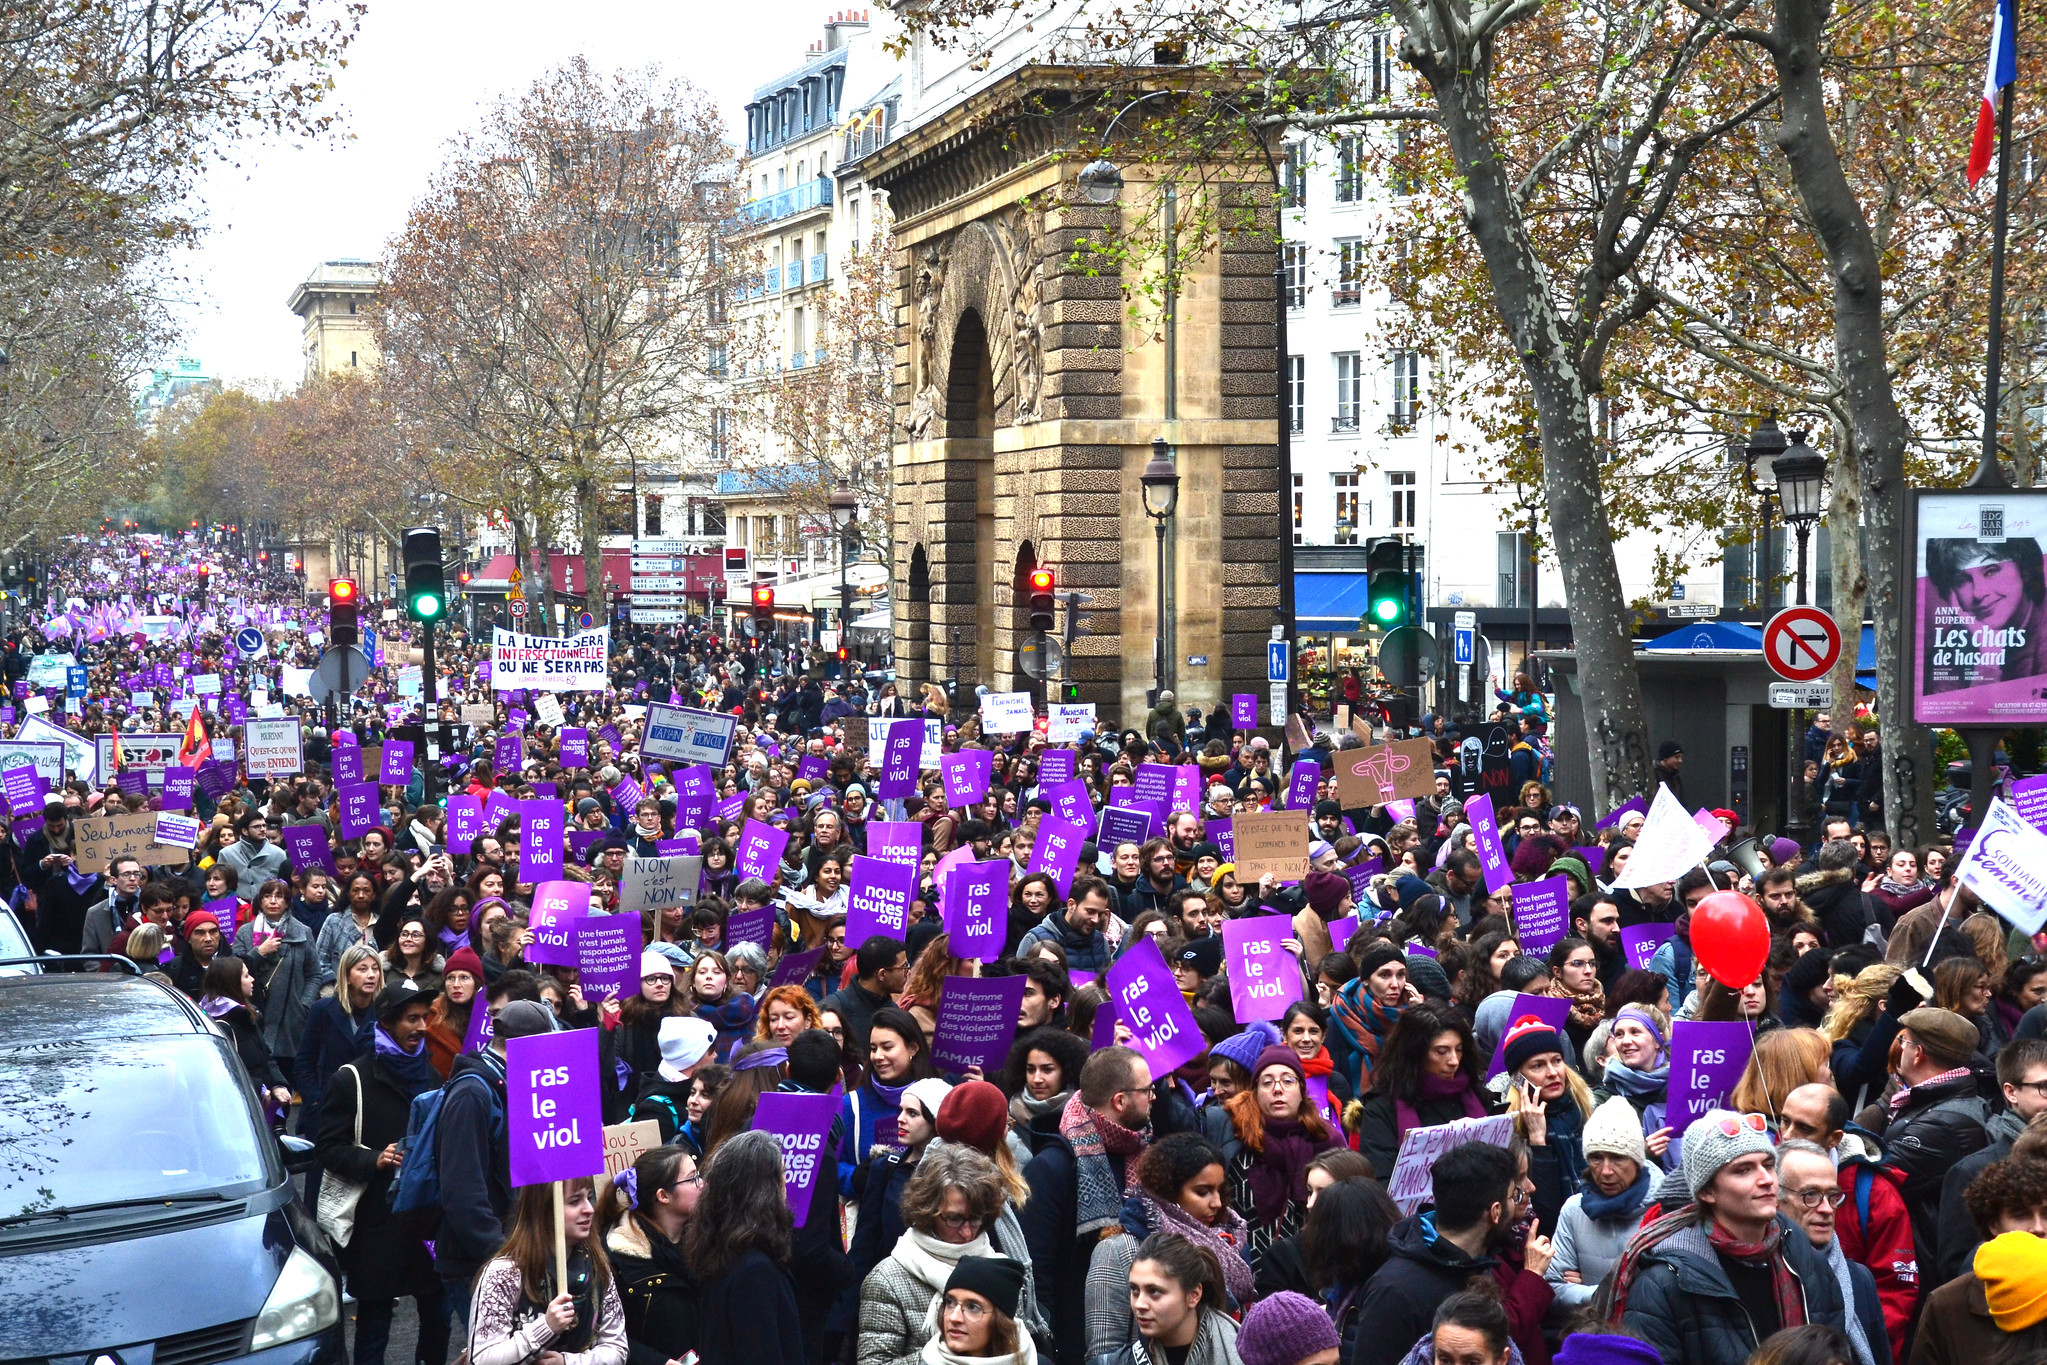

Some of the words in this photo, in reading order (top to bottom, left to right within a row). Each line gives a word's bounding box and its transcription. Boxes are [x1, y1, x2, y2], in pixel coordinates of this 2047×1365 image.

[512, 605, 523, 613] 30
[498, 635, 516, 647] LA
[524, 636, 569, 649] LUTTE
[574, 635, 604, 647] SERA
[1934, 628, 1967, 648] Les
[1972, 625, 2026, 648] chats
[498, 648, 604, 660] INTERSECTIONNELLE
[1933, 650, 1952, 666] de
[1955, 649, 2005, 666] hasard
[499, 661, 516, 673] OU
[522, 661, 538, 673] NE
[545, 660, 582, 674] SERA
[584, 660, 604, 673] PAS
[566, 675, 578, 686] 62
[870, 723, 887, 740] JE
[894, 738, 910, 748] ras
[268, 758, 297, 768] ENTEND
[891, 753, 901, 765] le
[341, 771, 356, 779] viol
[388, 767, 404, 776] viol
[889, 767, 909, 781] viol
[950, 765, 965, 773] ras
[952, 775, 962, 784] le
[1483, 769, 1509, 788] NON
[954, 783, 973, 795] viol
[13, 801, 34, 810] JAMAIS
[350, 795, 366, 804] ras
[350, 806, 360, 816] le
[458, 808, 474, 816] ras
[351, 816, 370, 826] viol
[458, 819, 468, 829] le
[532, 818, 550, 830] ras
[80, 822, 155, 842] Seulement
[457, 830, 477, 841] viol
[531, 834, 542, 847] le
[751, 836, 770, 849] ras
[1048, 833, 1067, 849] ras
[106, 848, 118, 860] je
[123, 843, 136, 853] dis
[531, 849, 553, 864] viol
[746, 846, 758, 860] le
[882, 845, 917, 856] nous
[634, 859, 671, 874] NON
[743, 862, 764, 878] viol
[1250, 863, 1266, 871] DANS
[1271, 863, 1278, 872] LE
[644, 875, 674, 886] c'est
[644, 887, 676, 904] NON
[865, 886, 905, 903] nous
[544, 898, 568, 910] ras
[853, 895, 903, 916] toutes
[541, 913, 556, 927] le
[876, 914, 904, 930] .org
[578, 930, 595, 938] Une
[596, 928, 623, 937] femme
[538, 932, 568, 947] viol
[600, 937, 626, 946] jamais
[580, 945, 628, 956] responsable
[1522, 944, 1555, 956] JAMAIS
[580, 957, 594, 965] des
[595, 954, 632, 963] violences
[581, 965, 608, 974] qu'elle
[609, 963, 630, 971] subit.
[584, 983, 621, 992] JAMAIS
[935, 1051, 984, 1065] JAMAIS
[530, 1065, 569, 1088] ras
[533, 1094, 556, 1118] le
[533, 1119, 581, 1150] viol
[772, 1133, 821, 1149] nous
[1402, 1132, 1418, 1158] LE
[784, 1150, 816, 1169] tes
[1390, 1160, 1430, 1197] JAMAIS
